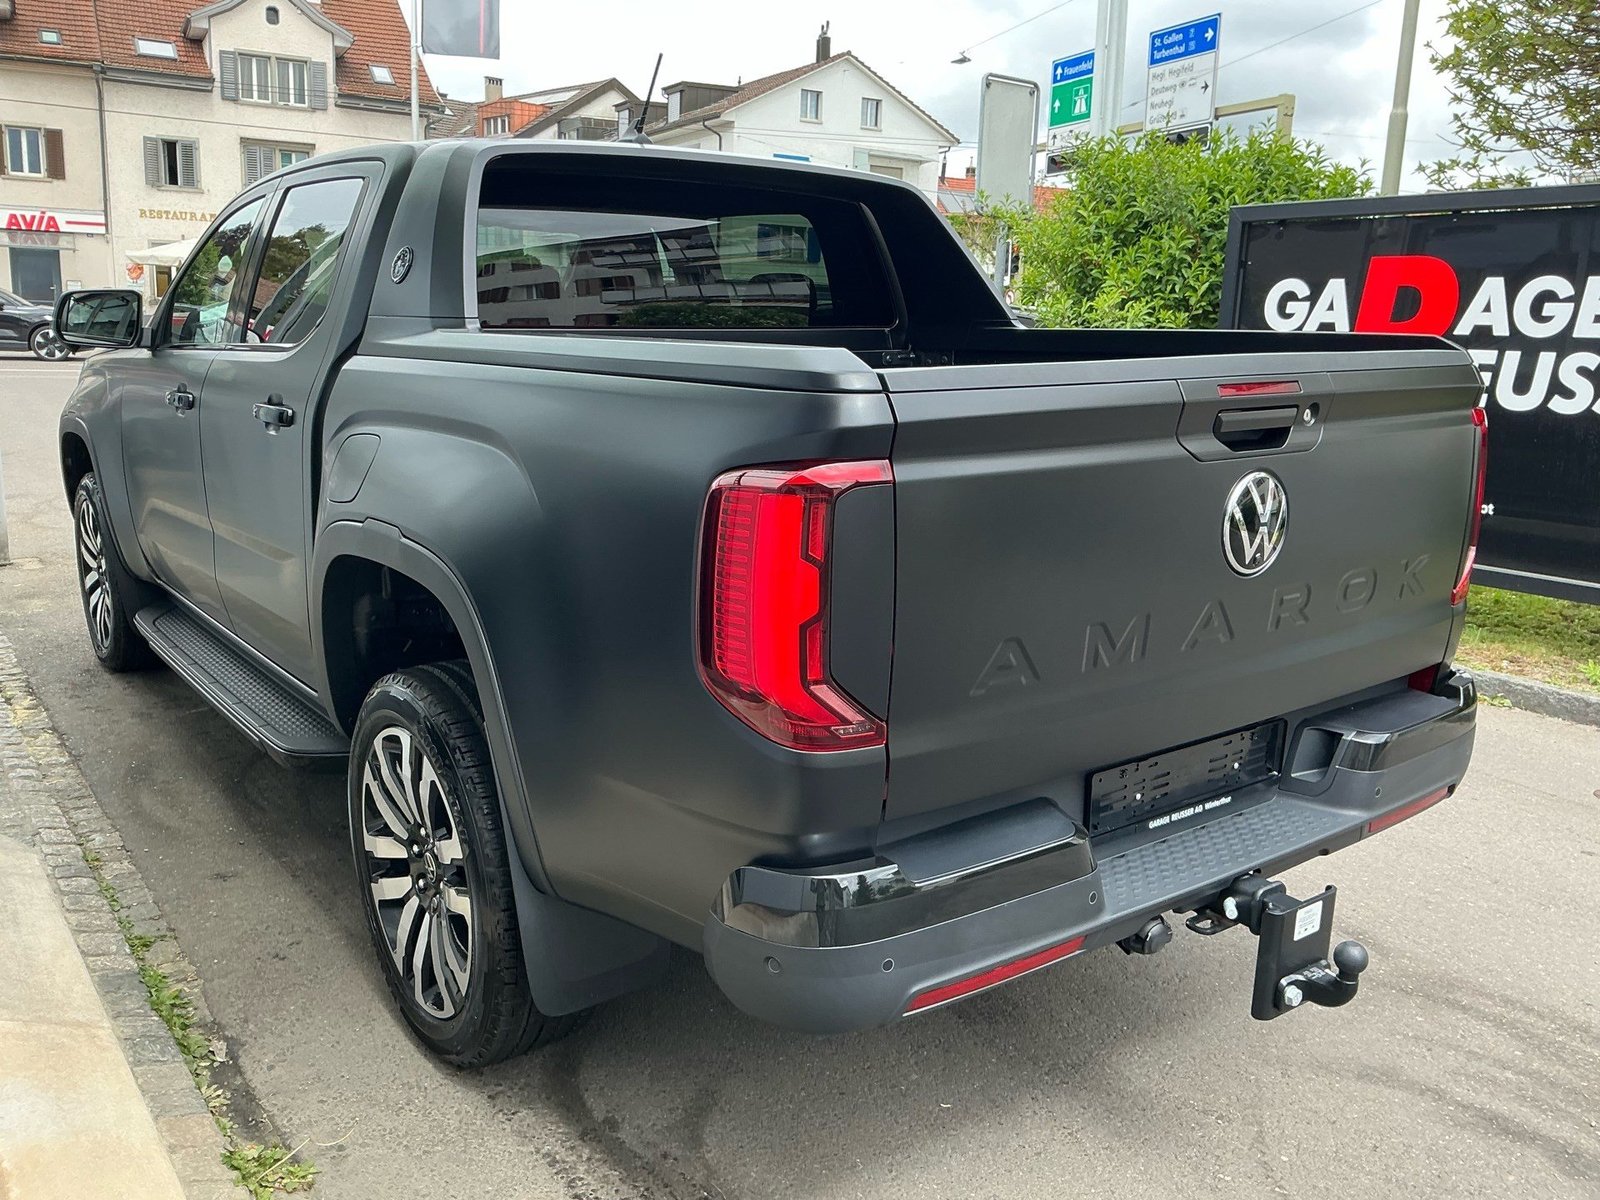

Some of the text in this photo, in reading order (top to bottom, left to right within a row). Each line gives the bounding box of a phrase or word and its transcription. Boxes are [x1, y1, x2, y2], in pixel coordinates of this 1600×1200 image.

[1163, 32, 1183, 45] Gallen
[1063, 59, 1093, 76] Frauenfeld
[6, 210, 60, 232] AVIA
[969, 554, 1432, 697] AMAROK
[1148, 815, 1170, 829] GARAGE
[1171, 807, 1195, 822] REUSSER
